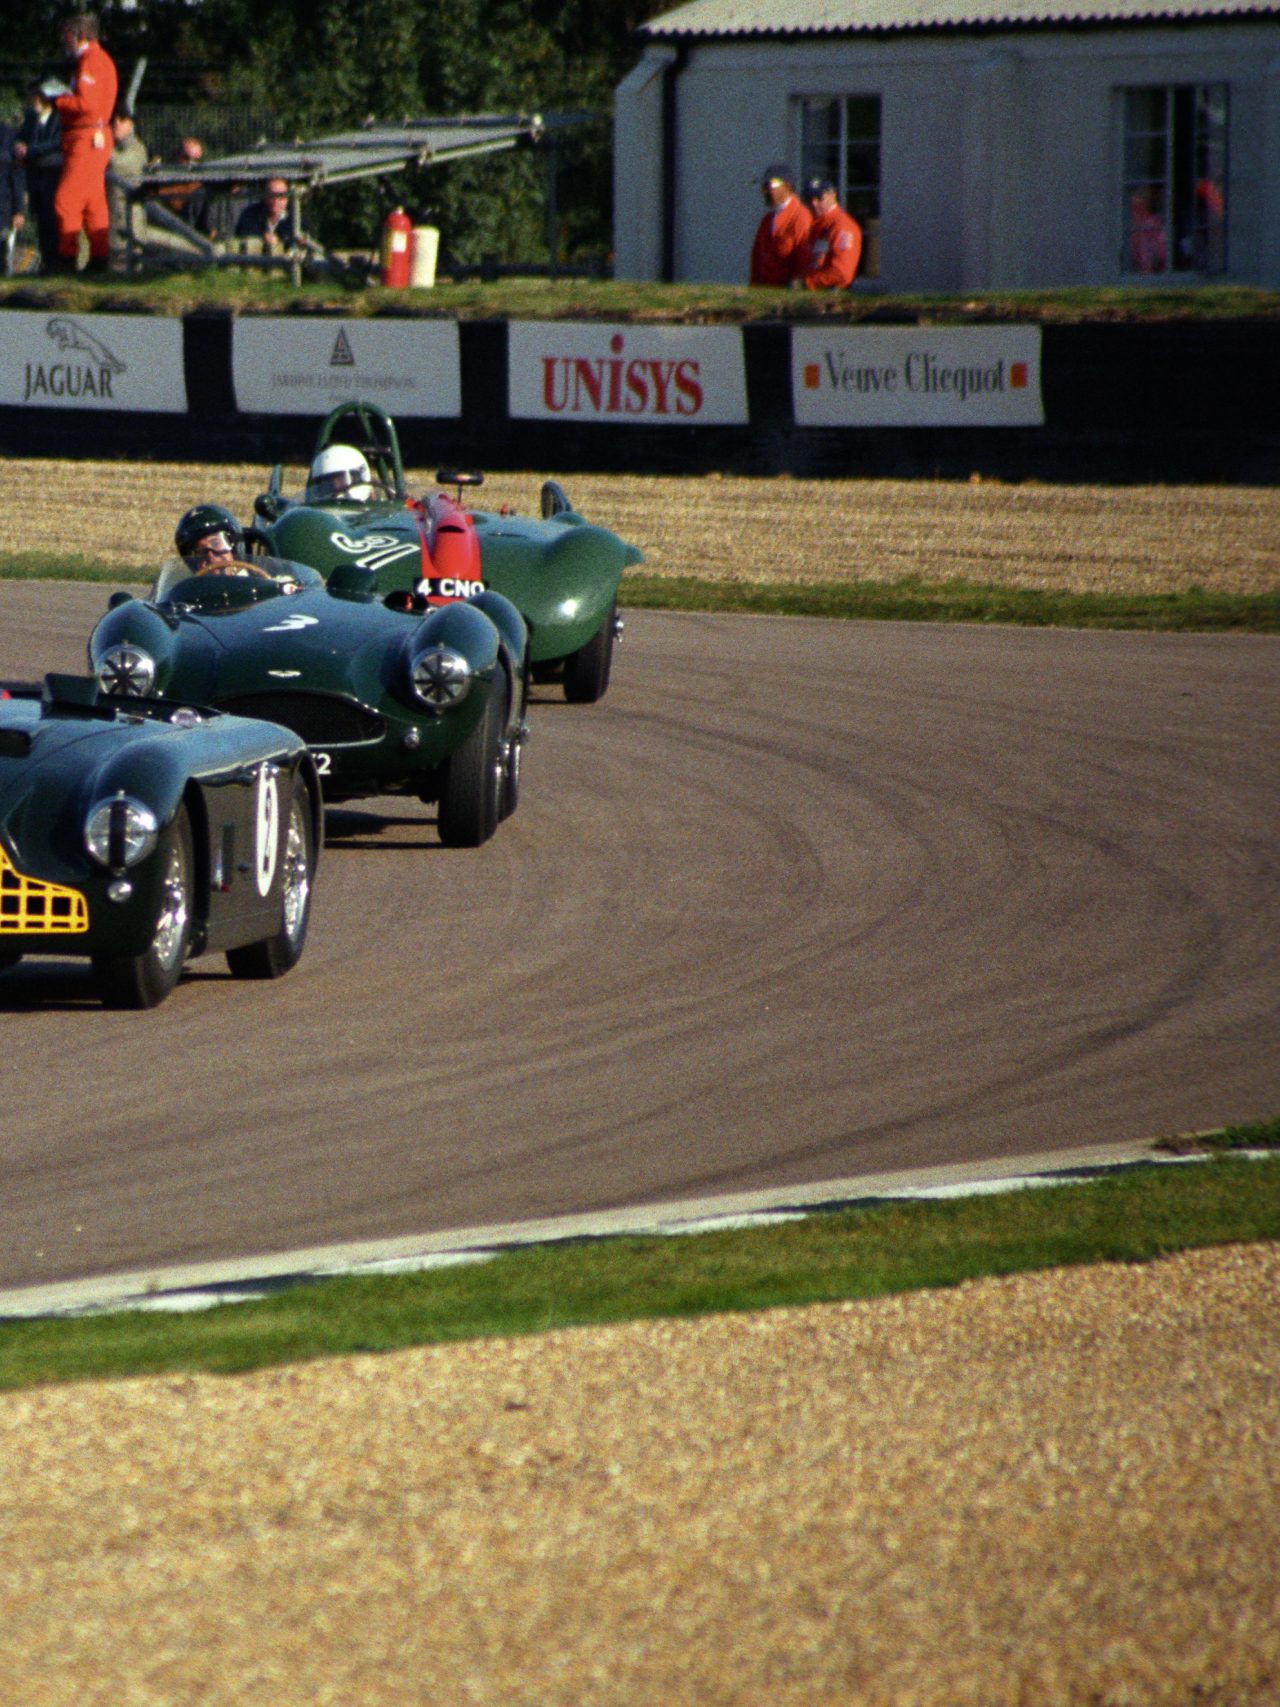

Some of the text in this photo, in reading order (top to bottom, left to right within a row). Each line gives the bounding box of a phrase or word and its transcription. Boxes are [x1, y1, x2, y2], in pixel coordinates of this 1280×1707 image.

[24, 362, 115, 401] JAGUAR
[541, 333, 704, 416] UNISYS
[825, 351, 1005, 401] Veuve Clicquot
[330, 532, 421, 571] 31
[417, 578, 432, 596] 4
[262, 613, 319, 631] 3
